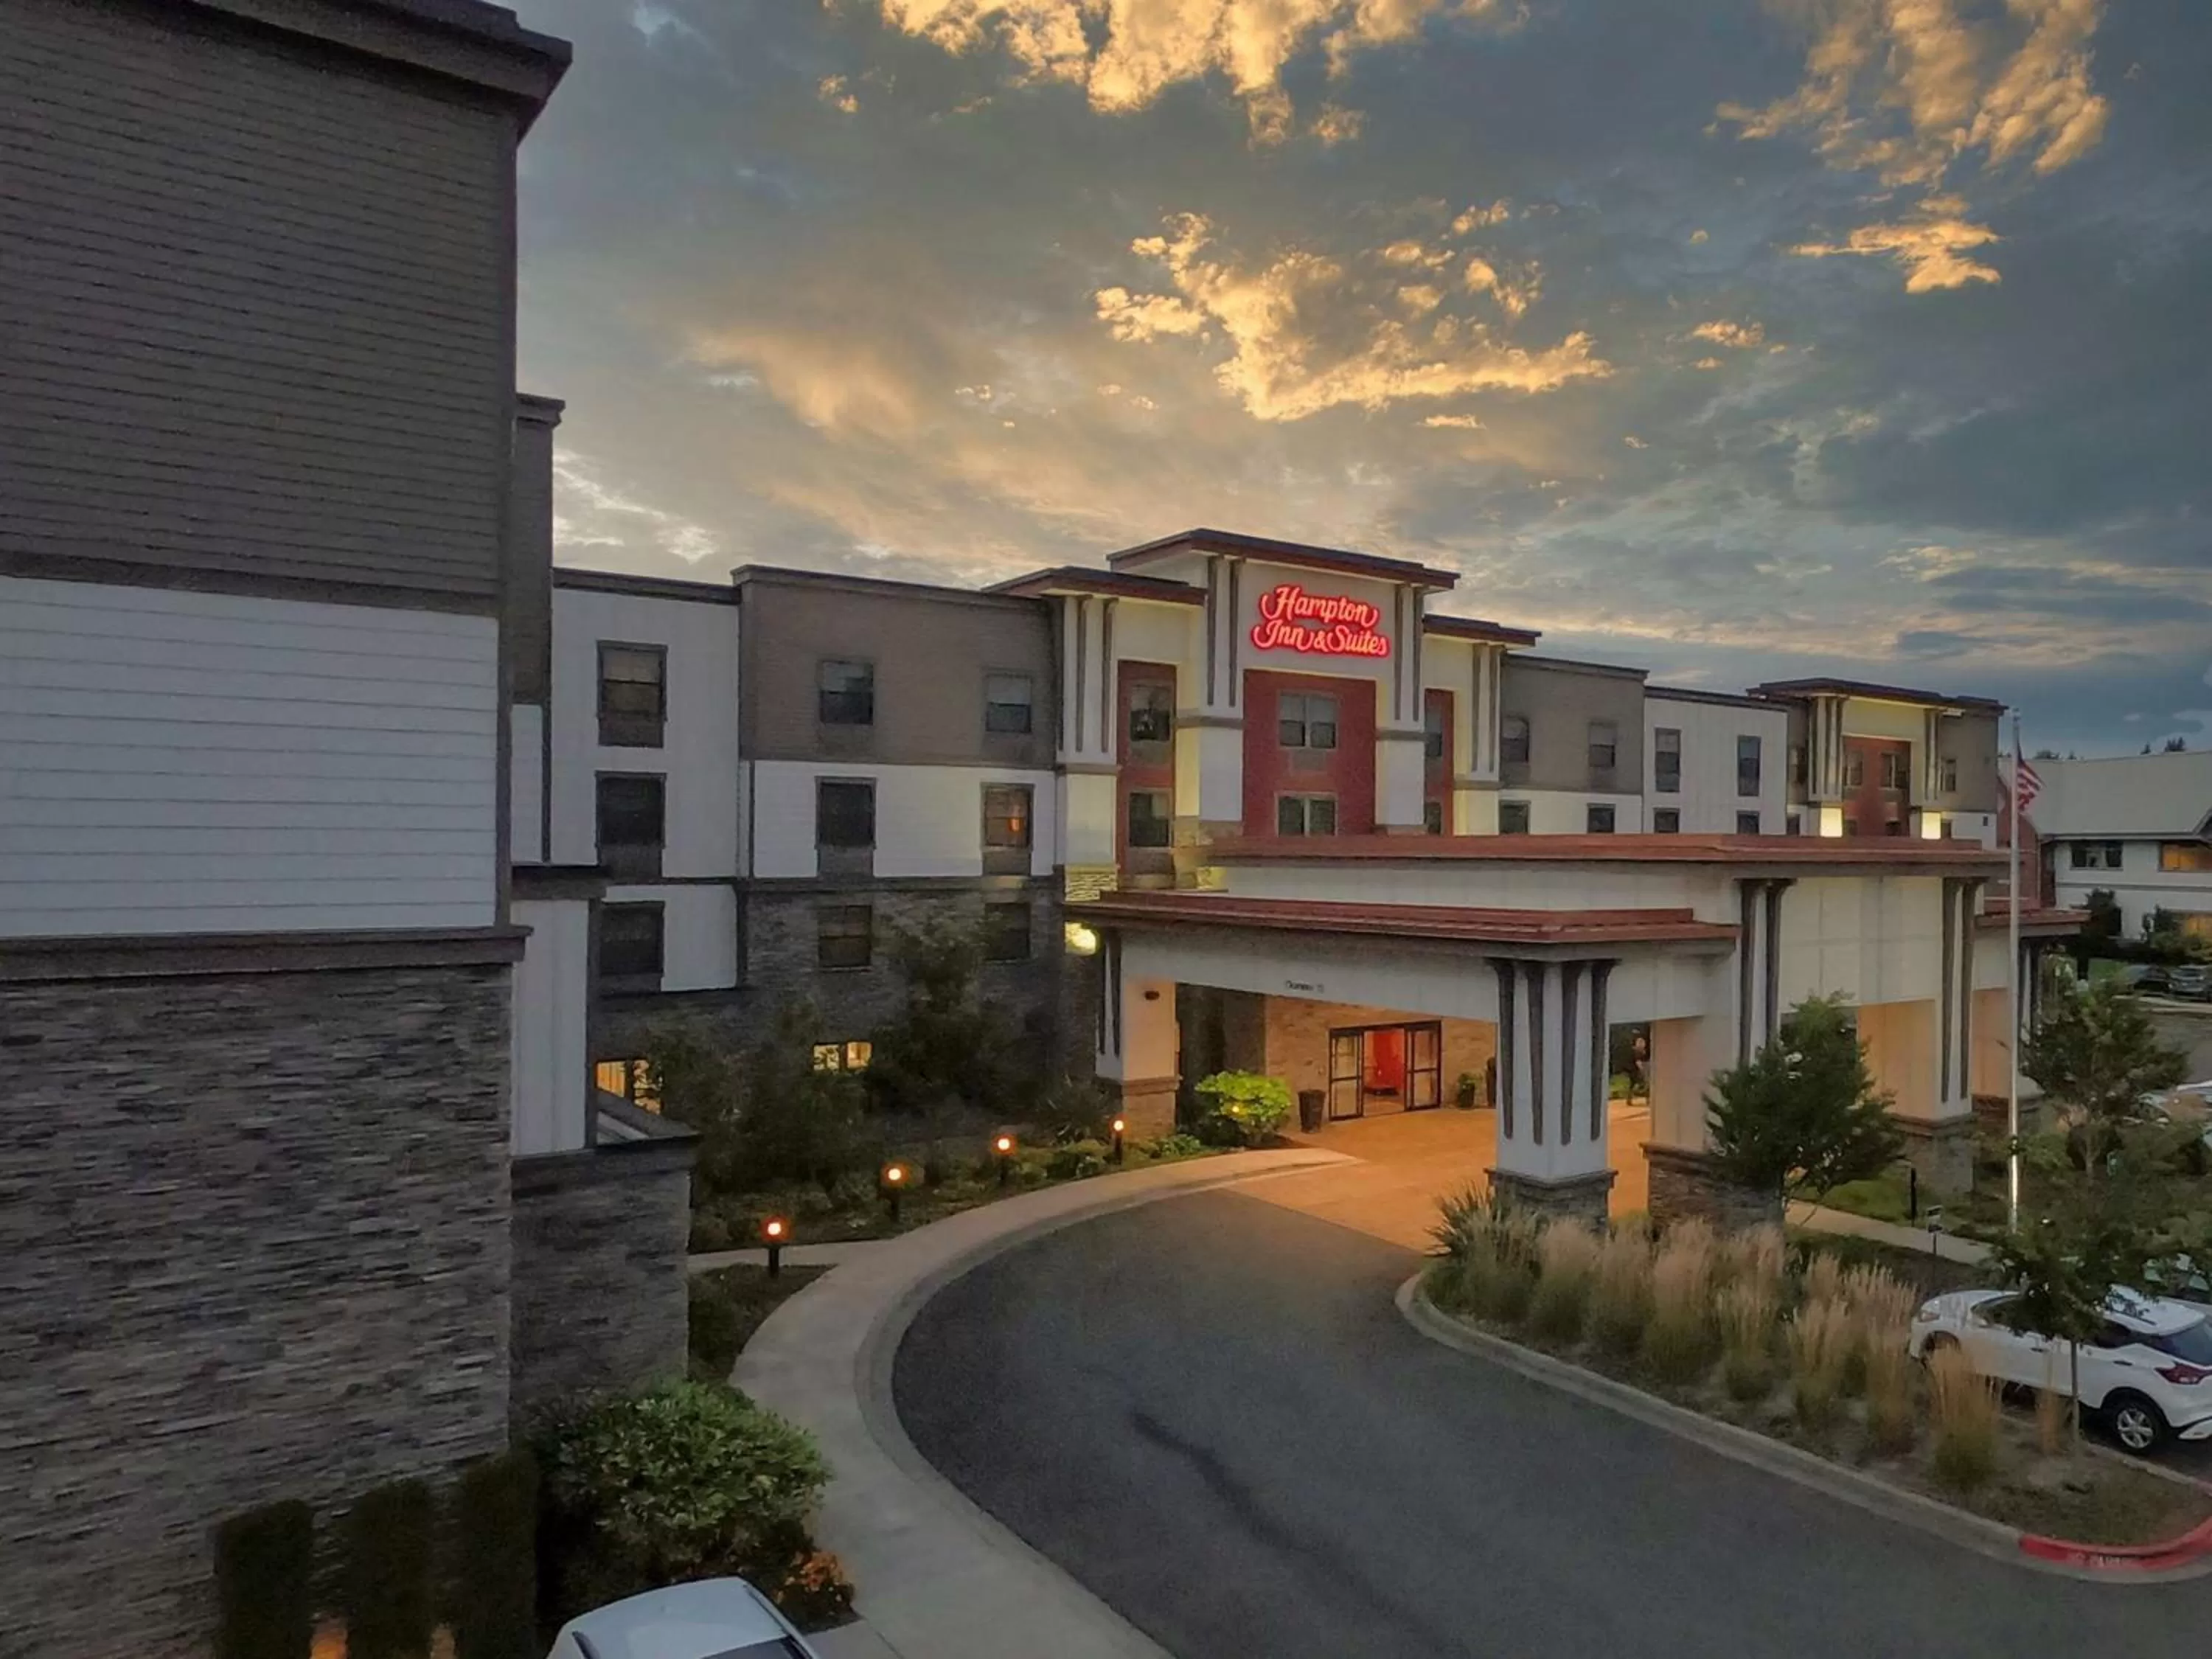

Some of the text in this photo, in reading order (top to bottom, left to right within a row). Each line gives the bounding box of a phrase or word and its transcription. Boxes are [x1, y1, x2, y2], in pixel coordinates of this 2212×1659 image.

[1259, 585, 1379, 627] Hampton
[1253, 619, 1314, 651] Inn
[1328, 625, 1388, 655] Suites
